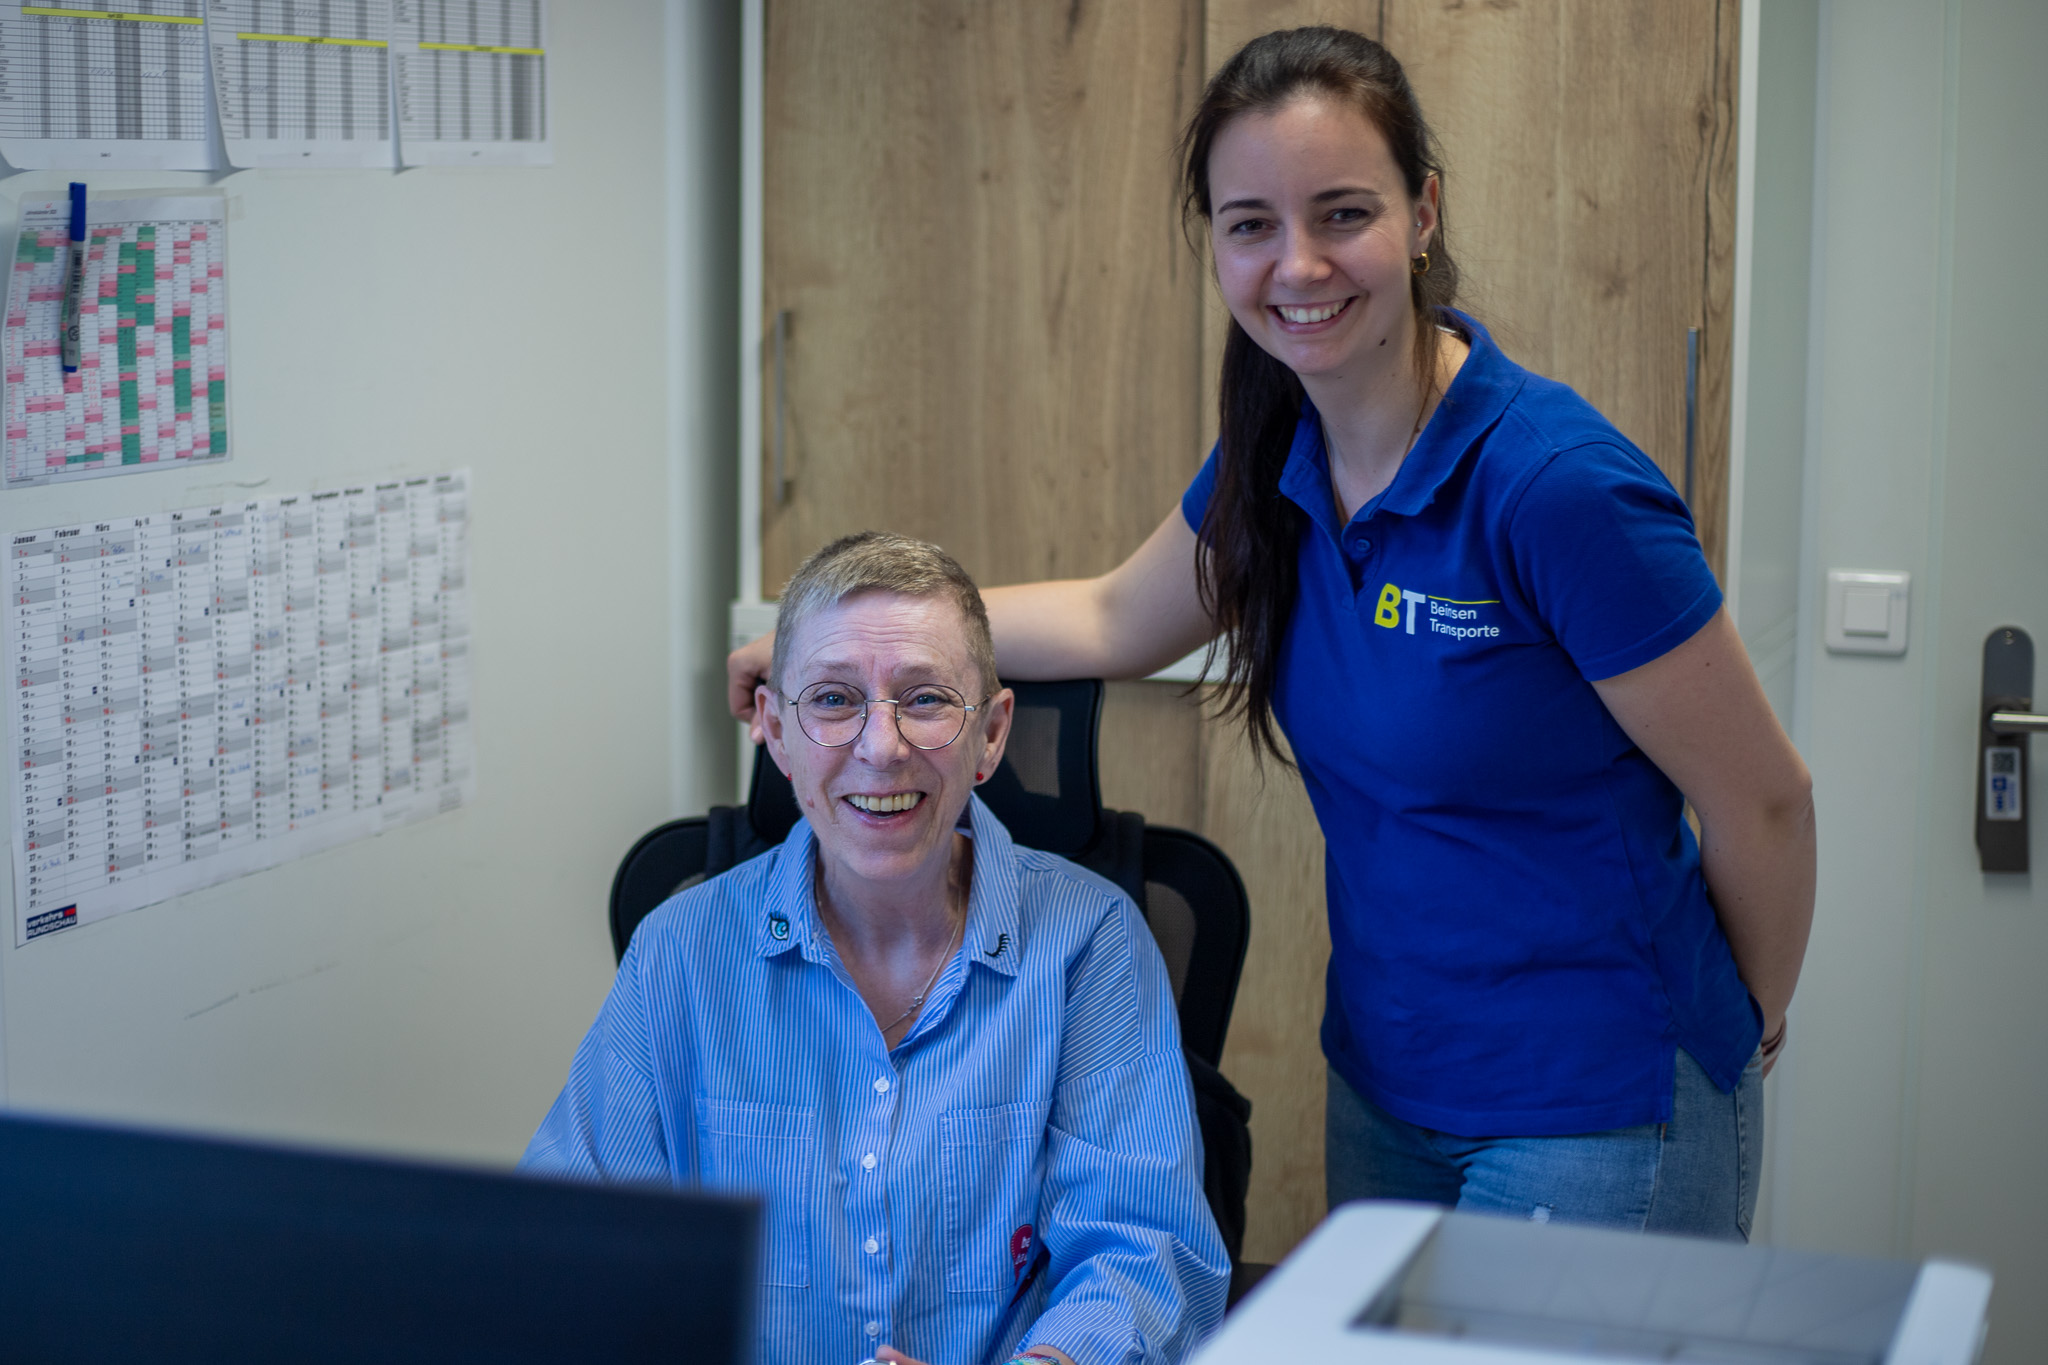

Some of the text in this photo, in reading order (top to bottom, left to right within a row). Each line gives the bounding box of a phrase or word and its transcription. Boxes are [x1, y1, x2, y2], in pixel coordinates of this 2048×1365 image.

[172, 513, 182, 521] Mai
[54, 528, 80, 538] Februar
[95, 523, 110, 532] März
[13, 534, 36, 545] Januar
[1374, 582, 1426, 635] BT
[1430, 600, 1477, 619] Beinsen
[1429, 618, 1500, 641] Transporte
[27, 911, 63, 928] verkehrs
[27, 914, 76, 937] RUNDSCHAU
